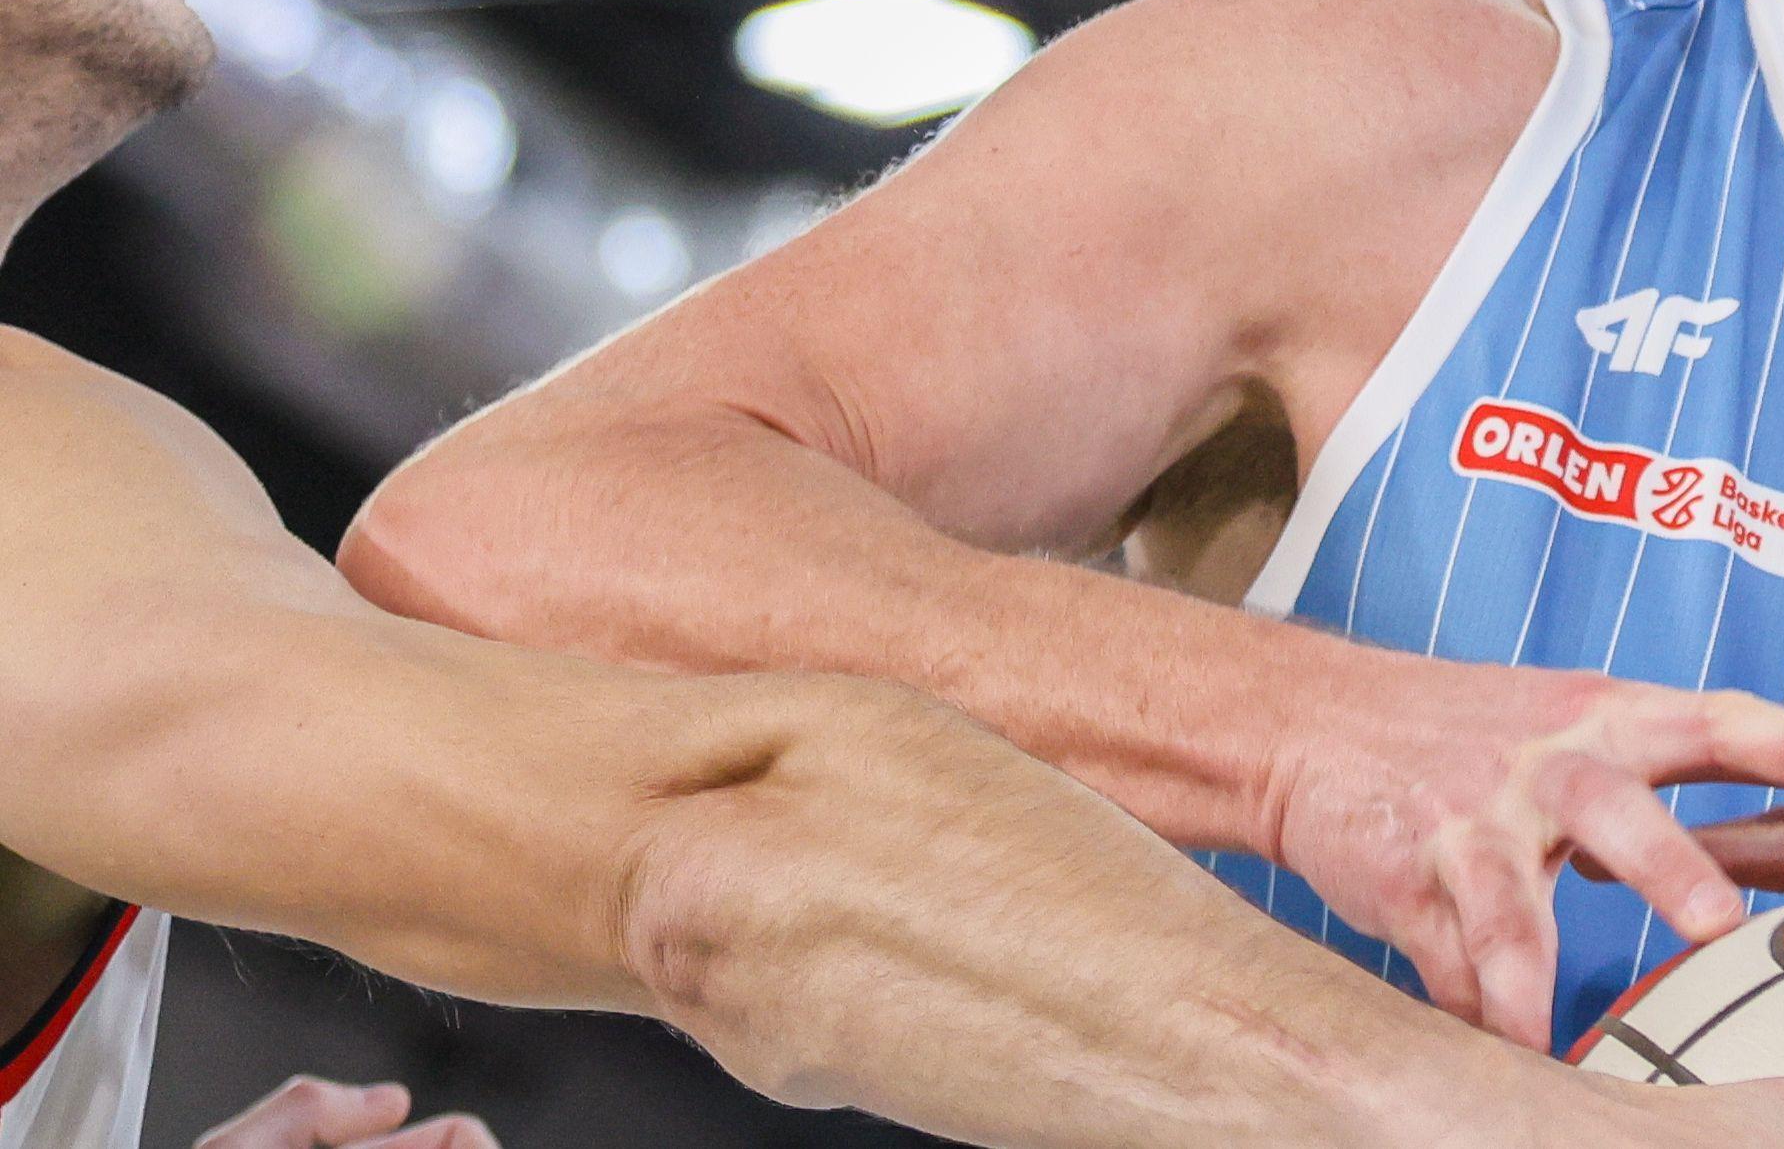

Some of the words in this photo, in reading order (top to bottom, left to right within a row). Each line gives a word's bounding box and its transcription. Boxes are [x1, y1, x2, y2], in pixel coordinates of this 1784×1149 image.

[1575, 288, 1740, 377] 4F
[1472, 416, 1626, 502] ORLEN
[1712, 503, 1762, 552] Liga
